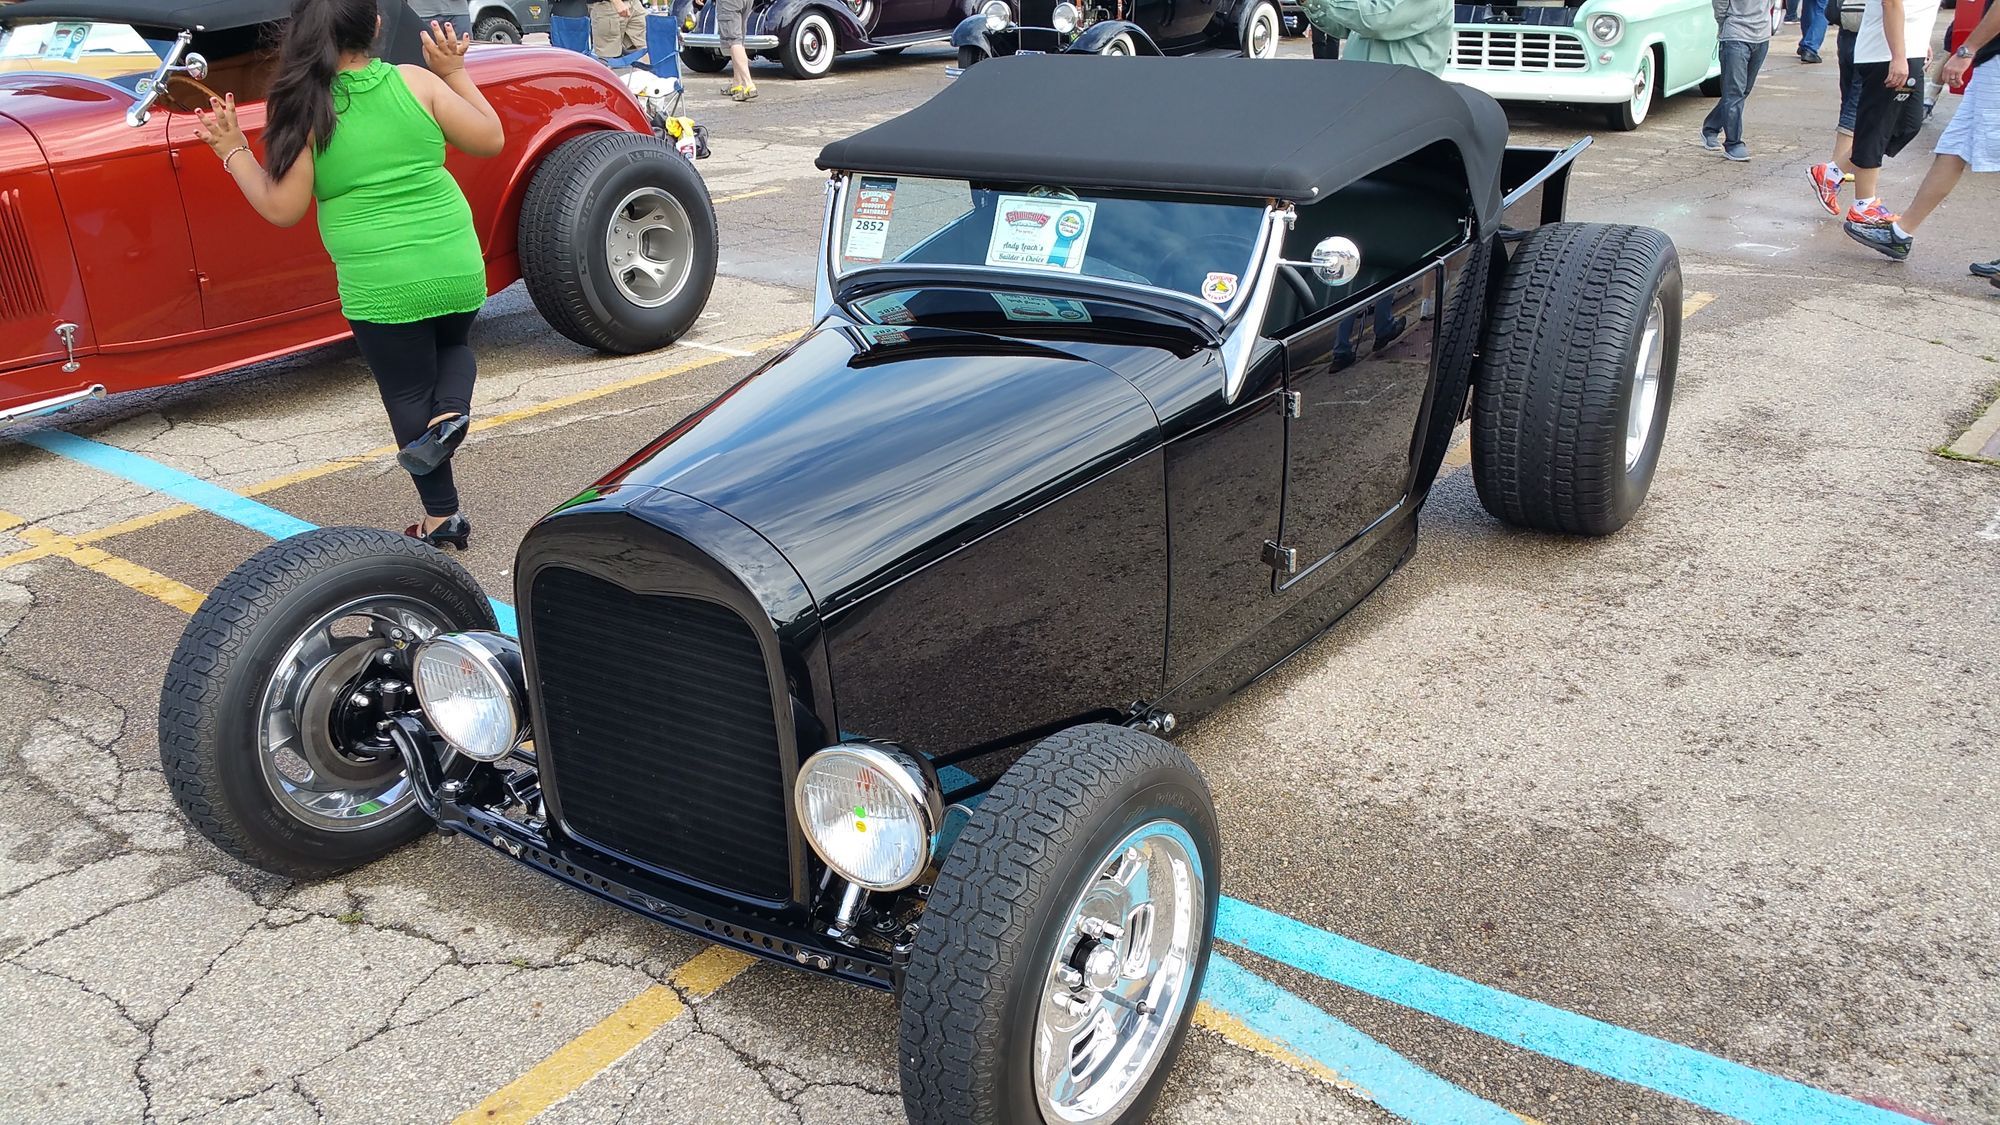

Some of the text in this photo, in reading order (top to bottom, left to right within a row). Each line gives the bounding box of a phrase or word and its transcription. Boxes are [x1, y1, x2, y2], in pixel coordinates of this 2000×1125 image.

[856, 220, 884, 231] 2852
[1003, 241, 1020, 251] Andy
[1025, 254, 1045, 263] Choice
